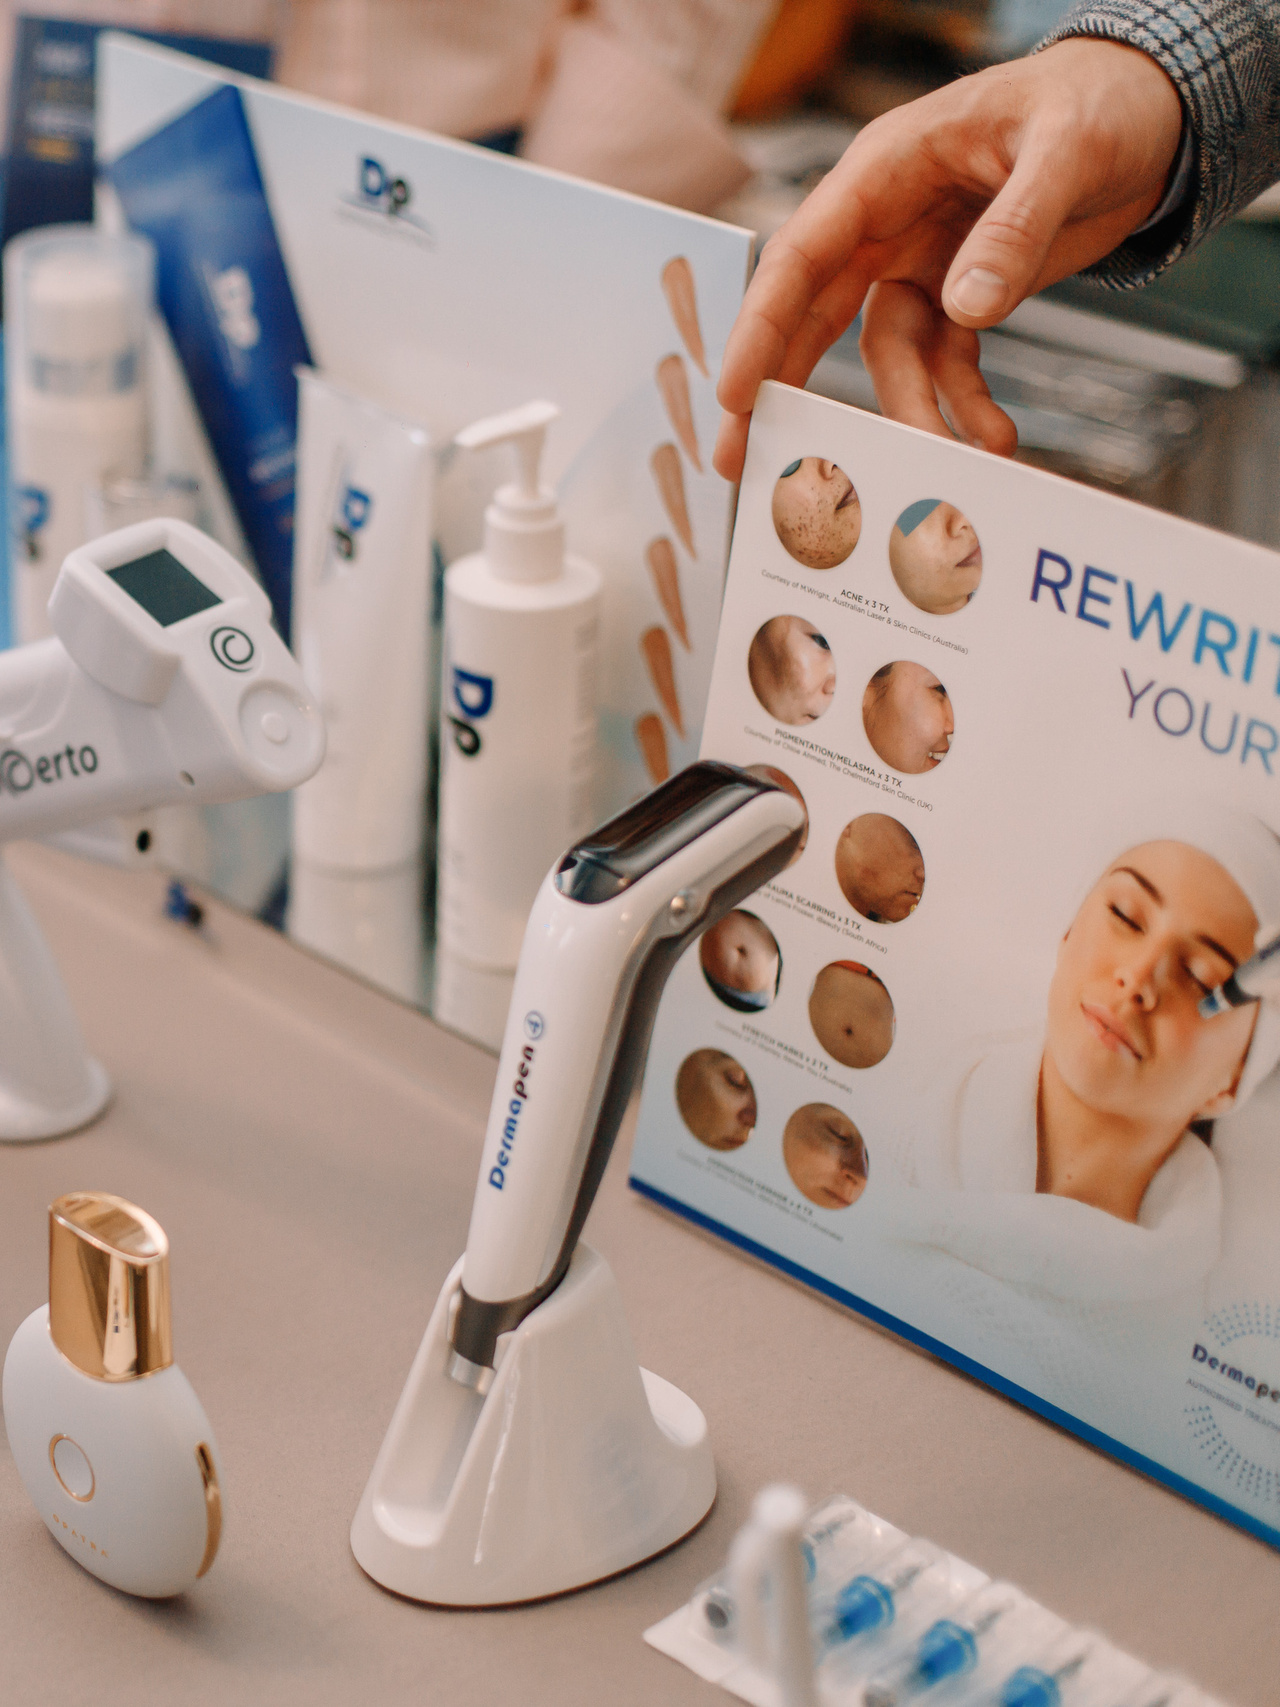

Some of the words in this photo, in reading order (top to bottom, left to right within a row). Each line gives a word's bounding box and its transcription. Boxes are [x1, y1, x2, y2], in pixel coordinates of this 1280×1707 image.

[761, 569, 791, 587] Courtesy
[791, 581, 800, 590] of
[832, 597, 866, 614] Australian
[866, 610, 886, 622] Laser
[893, 620, 908, 631] Skin
[909, 626, 932, 641] Clinics
[932, 634, 969, 656] (Australia)
[840, 588, 864, 604] ACNE
[871, 600, 878, 609] 3
[879, 602, 890, 614] TX
[1121, 666, 1280, 776] YOUR
[774, 728, 876, 776] PIGMENTATION/MELASMA
[891, 777, 902, 788] TX
[828, 761, 841, 772] The
[882, 784, 896, 796] Skin
[896, 790, 916, 804] Clinic
[916, 799, 934, 812] (UK)
[850, 921, 862, 931] TX
[488, 1045, 535, 1191] Dermapen
[1192, 1343, 1280, 1404] Dermape
